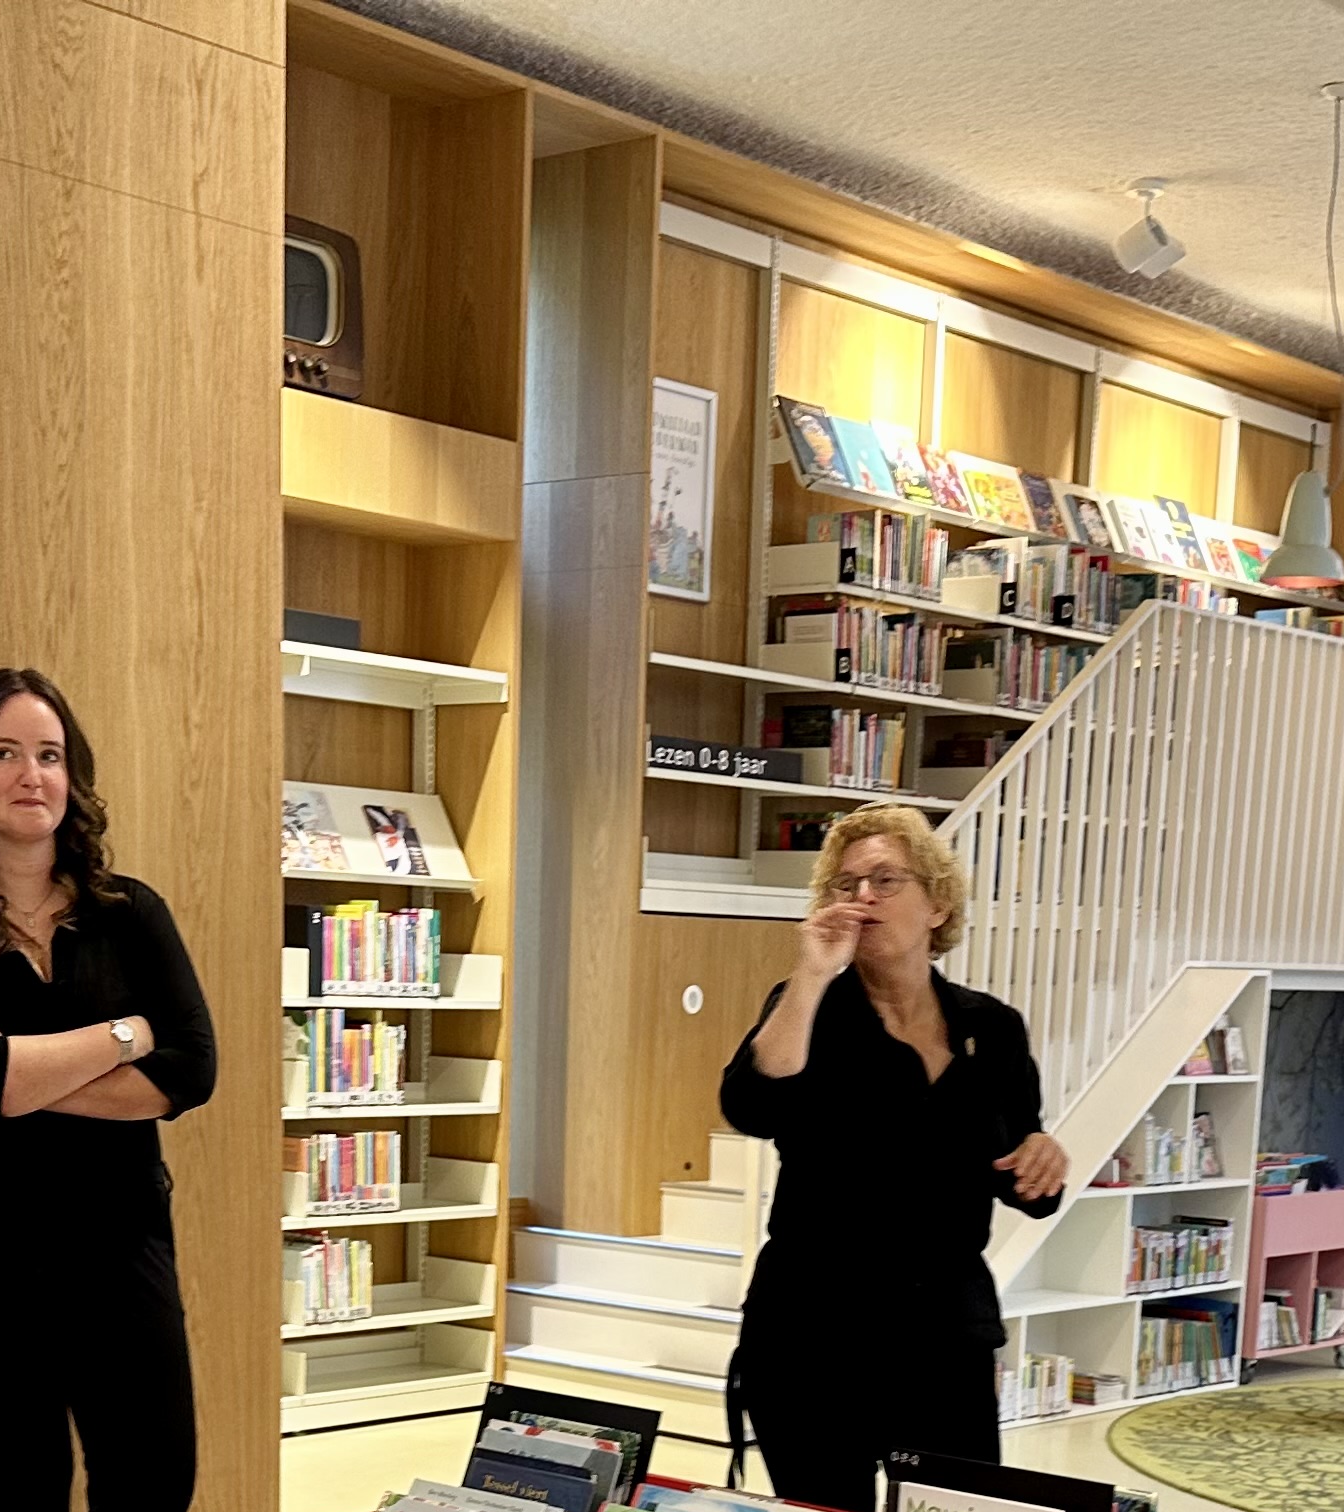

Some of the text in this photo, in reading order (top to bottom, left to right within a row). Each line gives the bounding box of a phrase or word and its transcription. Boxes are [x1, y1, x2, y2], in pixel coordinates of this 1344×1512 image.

[646, 741, 767, 778] Lezen 0-8 jaar
